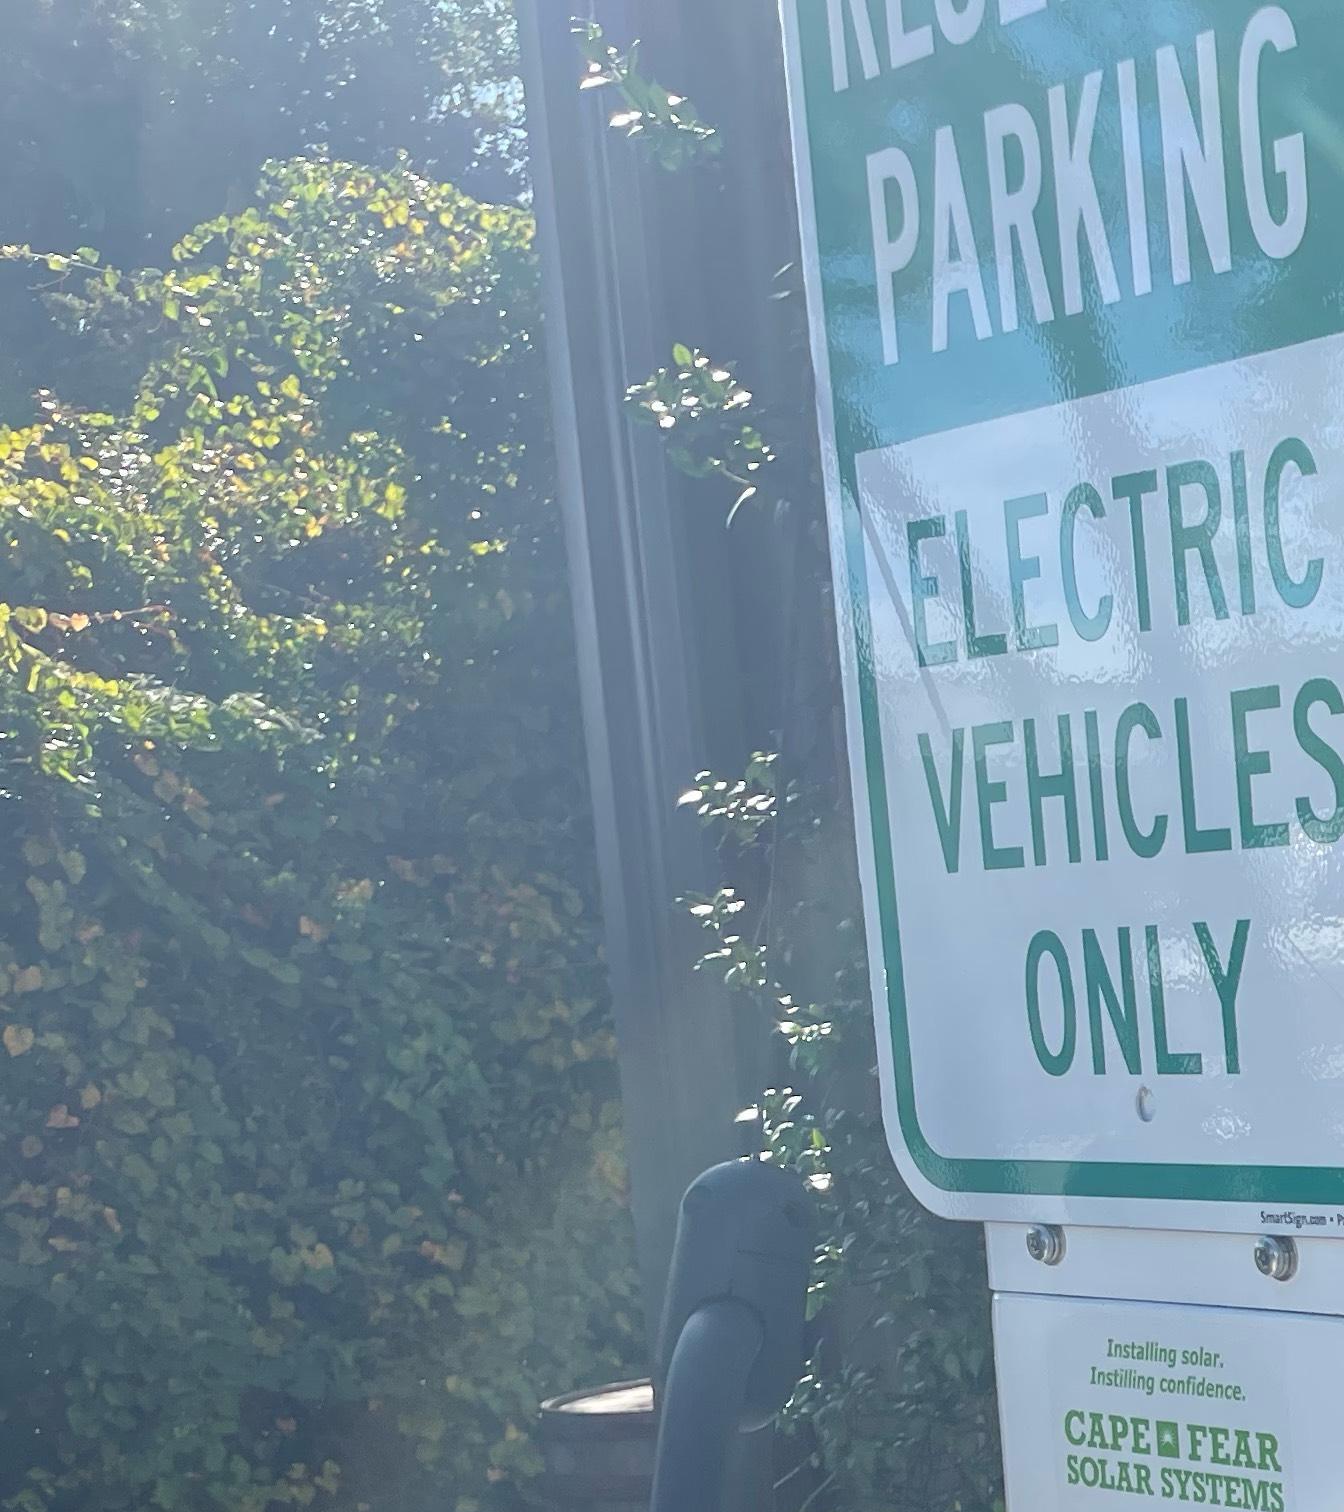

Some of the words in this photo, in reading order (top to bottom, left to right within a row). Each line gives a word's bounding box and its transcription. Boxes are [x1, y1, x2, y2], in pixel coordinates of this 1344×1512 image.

[866, 5, 1308, 366] PARKING
[907, 437, 1324, 667] ELECTRIC
[1025, 919, 1251, 1077] ONLY
[1260, 1210, 1327, 1229] SmartSign.com
[1106, 1338, 1177, 1368] Installing
[1181, 1346, 1224, 1369] solar.
[1090, 1366, 1154, 1396] Instilling
[1159, 1376, 1246, 1401] confidence.
[1064, 1408, 1151, 1455] CAPE
[1186, 1423, 1282, 1473] FEAR
[1066, 1453, 1154, 1496] SOLAR
